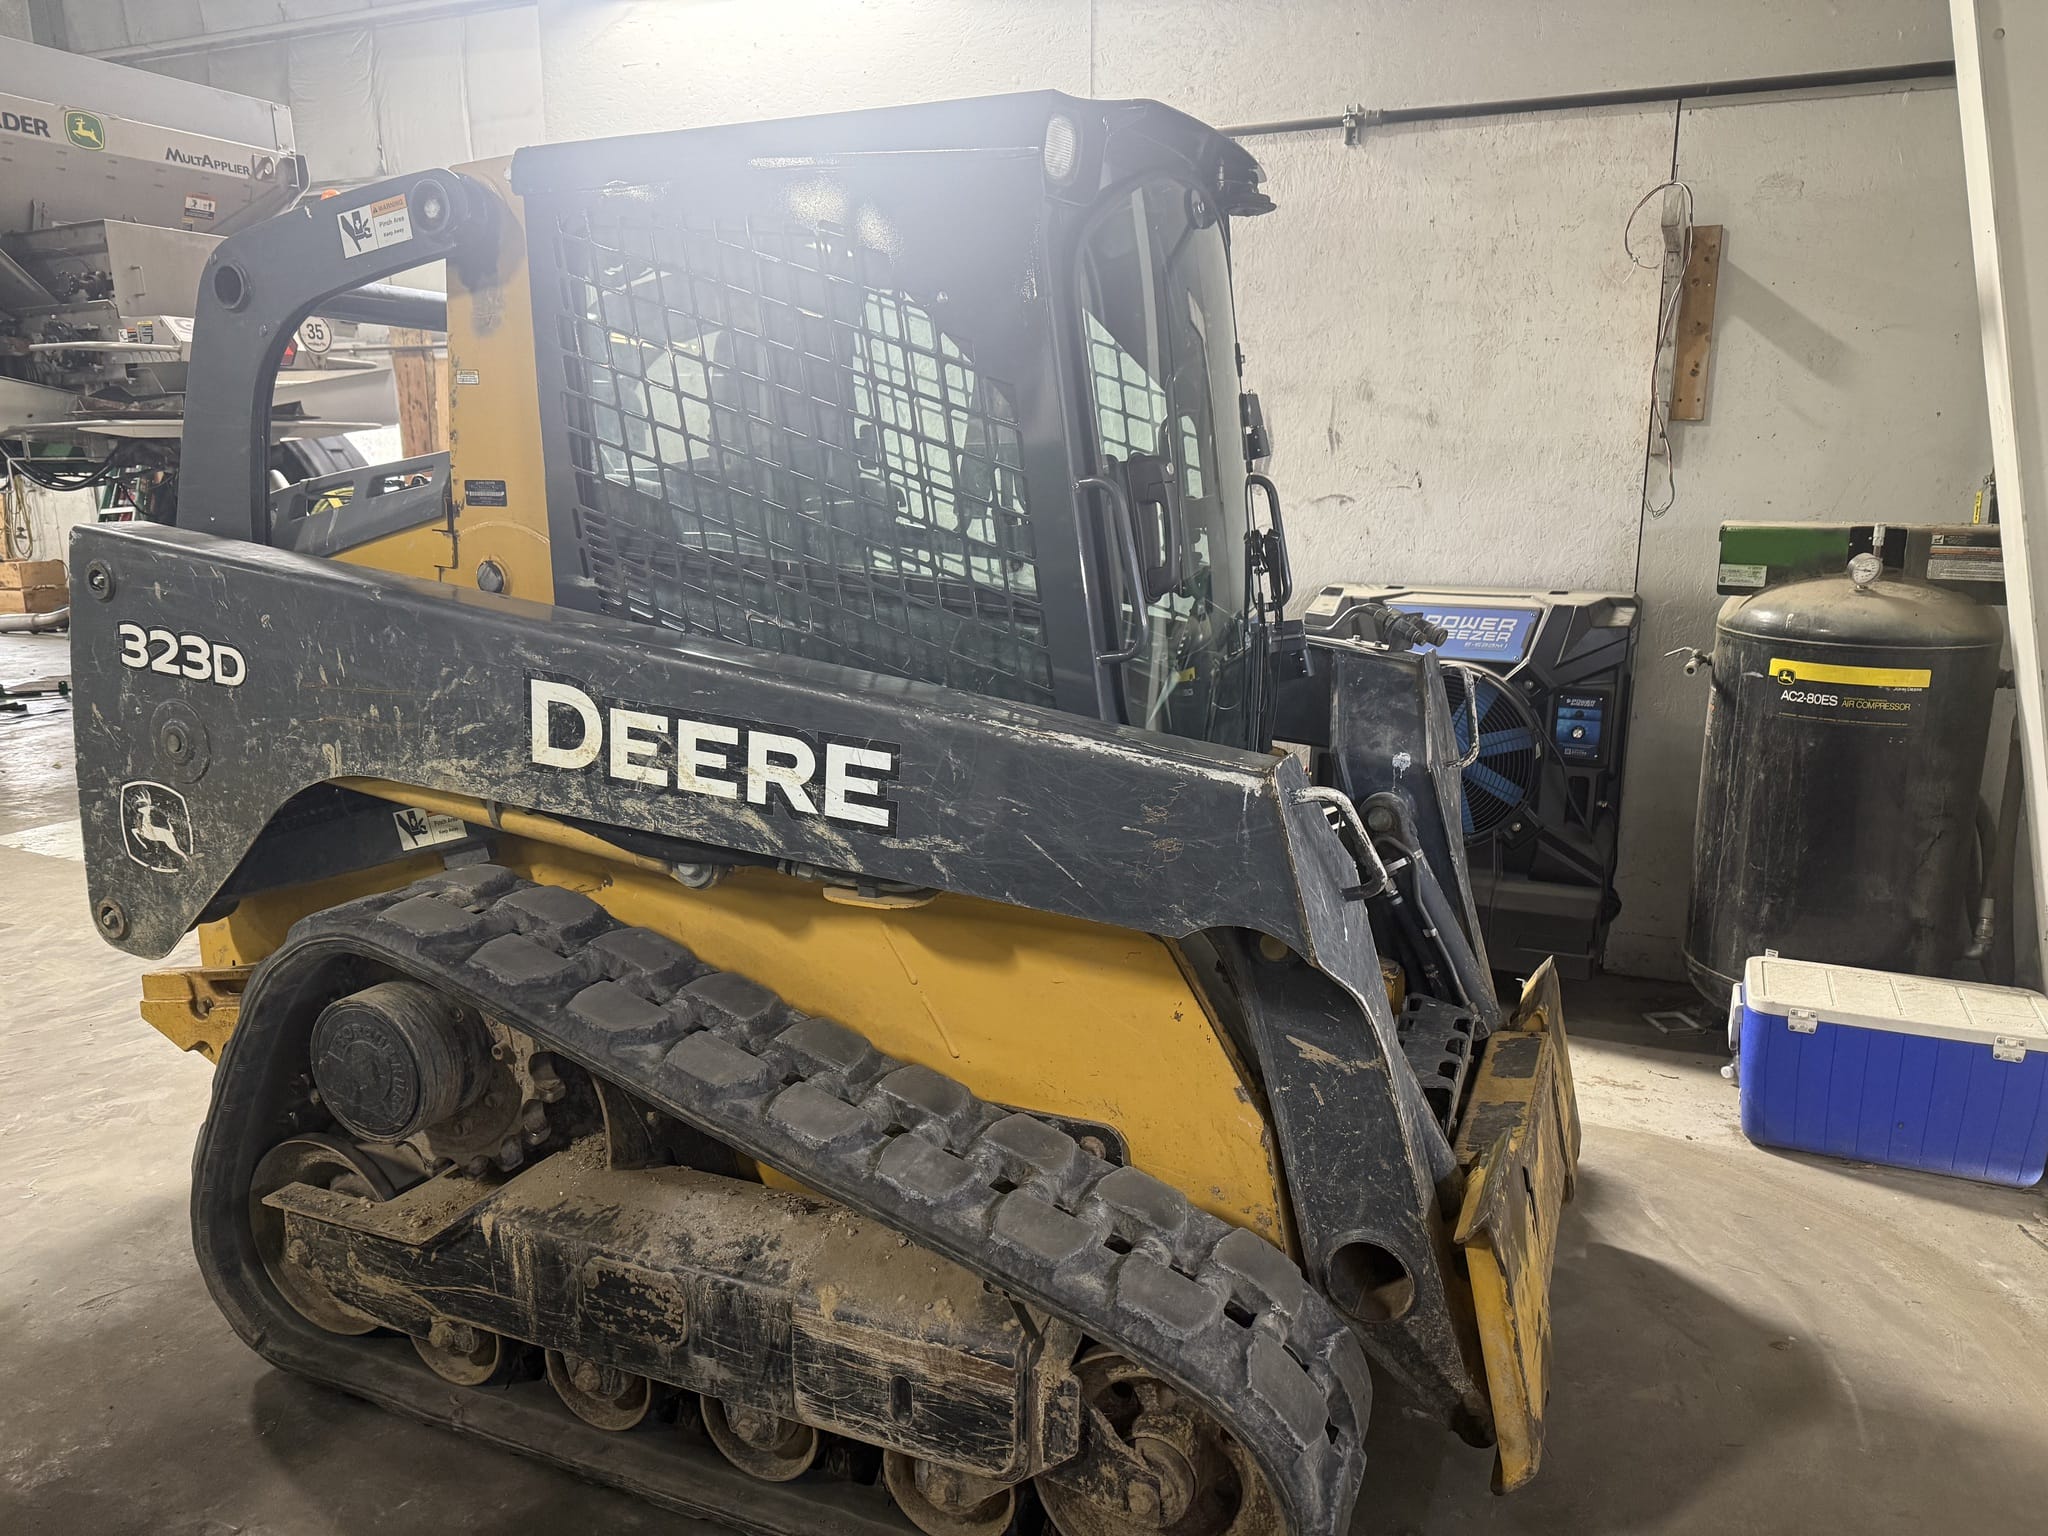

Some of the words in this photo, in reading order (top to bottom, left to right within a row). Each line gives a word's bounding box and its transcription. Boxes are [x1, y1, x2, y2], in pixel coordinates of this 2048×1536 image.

[306, 323, 324, 340] 35
[1425, 614, 1518, 632] POWER
[1447, 629, 1512, 643] EEZER
[117, 623, 246, 687] 323D
[1780, 689, 1839, 707] AC2-80ES
[1841, 699, 1855, 709] AIR
[1855, 700, 1911, 712] COMPRESSOR
[530, 678, 892, 827] DEERE
